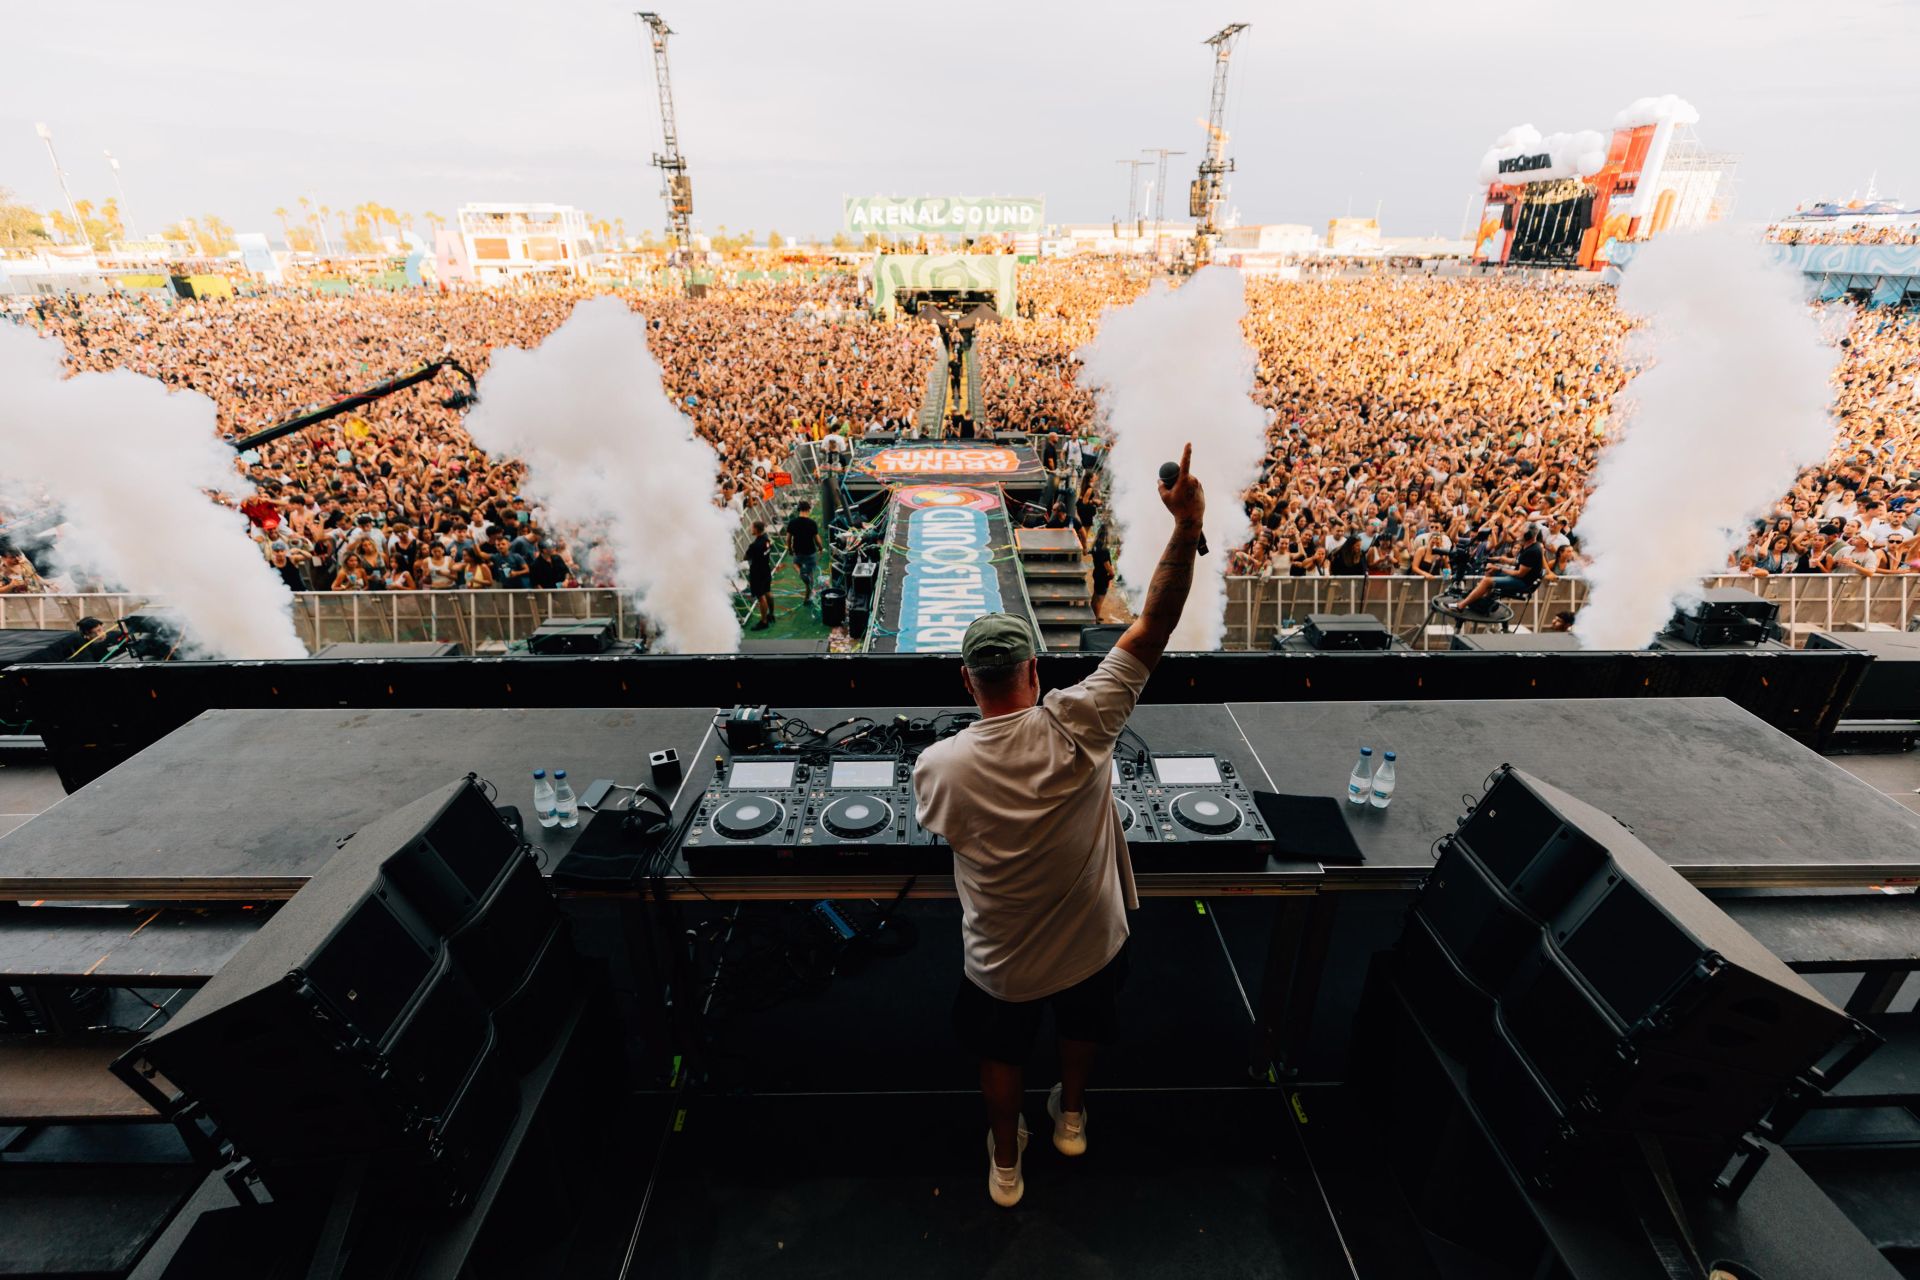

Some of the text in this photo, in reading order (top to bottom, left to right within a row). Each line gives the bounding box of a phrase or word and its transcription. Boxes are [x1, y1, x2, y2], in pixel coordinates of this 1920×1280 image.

[852, 205, 1035, 225] ARENAL SOUND
[882, 451, 1006, 461] SOUND
[882, 460, 1010, 471] ARENAL
[921, 509, 982, 574] SOUND
